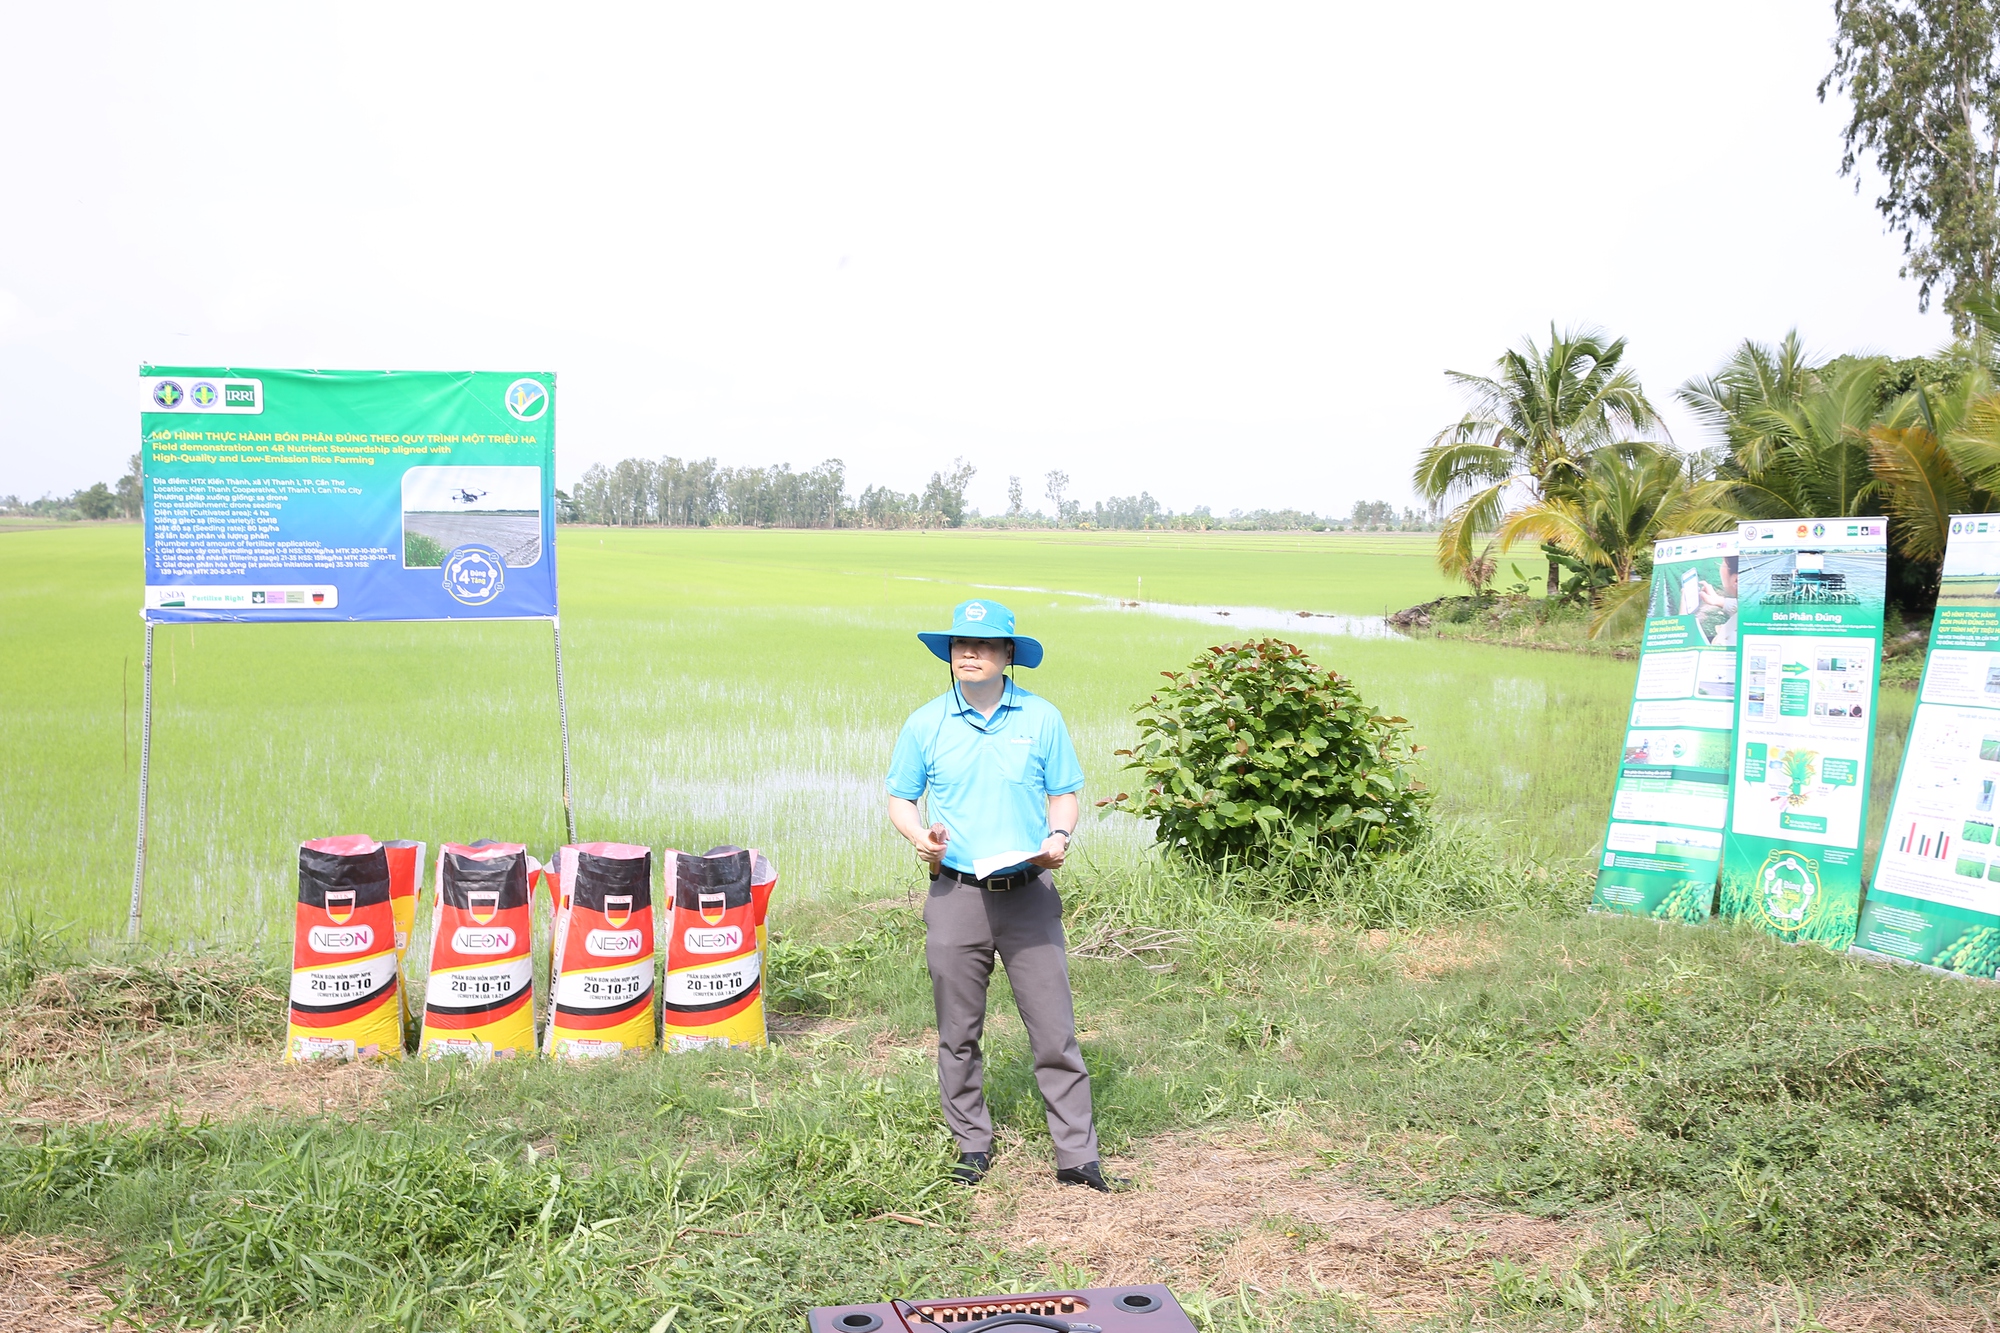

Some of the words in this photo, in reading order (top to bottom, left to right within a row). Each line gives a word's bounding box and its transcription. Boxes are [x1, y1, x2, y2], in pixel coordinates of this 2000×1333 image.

[226, 390, 254, 401] IRRI
[152, 429, 172, 440] MÔ
[173, 429, 203, 441] HÌNH
[205, 431, 237, 443] THỰC
[238, 430, 272, 442] HÀNH
[274, 431, 299, 442] BÓN
[301, 431, 333, 443] PHÂN
[335, 432, 368, 443] ĐÚNG
[369, 434, 400, 444] THEO
[401, 434, 425, 445] QUY
[426, 432, 460, 444] TRÌNH
[462, 432, 486, 445] MỘT
[487, 433, 519, 446] TRIỆU
[520, 435, 537, 444] HA
[152, 442, 178, 451] Field
[179, 442, 254, 452] demonstration
[270, 444, 285, 453] 4R
[287, 444, 328, 453] Nutrient
[330, 444, 391, 456] Stewardship
[392, 444, 428, 456] aligned
[429, 444, 452, 454] with
[152, 452, 217, 464] High-Quality
[218, 454, 239, 463] and
[240, 454, 309, 464] Low-Emission
[310, 454, 333, 464] Rice
[334, 455, 375, 466] Farming
[348, 487, 362, 495] City
[252, 502, 282, 510] seeding
[178, 517, 196, 525] gieo
[258, 524, 280, 533] kg/ha
[172, 568, 193, 576] kg/ha
[458, 570, 470, 584] 4
[470, 570, 487, 578] Đúng
[160, 590, 186, 598] USDA
[1772, 612, 1788, 620] Bón
[1789, 612, 1813, 621] Phân
[1815, 613, 1842, 623] Đúng
[1747, 749, 1752, 757] 1
[1846, 774, 1853, 783] 3
[1784, 815, 1790, 824] 2
[1771, 878, 1784, 898] 4
[314, 931, 368, 947] NEON
[456, 933, 509, 948] NEON
[590, 935, 638, 950] NEON
[689, 931, 737, 947] NEON
[312, 978, 371, 991] 20-10-10
[452, 981, 511, 993] 20-10-10
[584, 982, 640, 994] 20-10-10
[687, 977, 742, 990] 20-10-10
